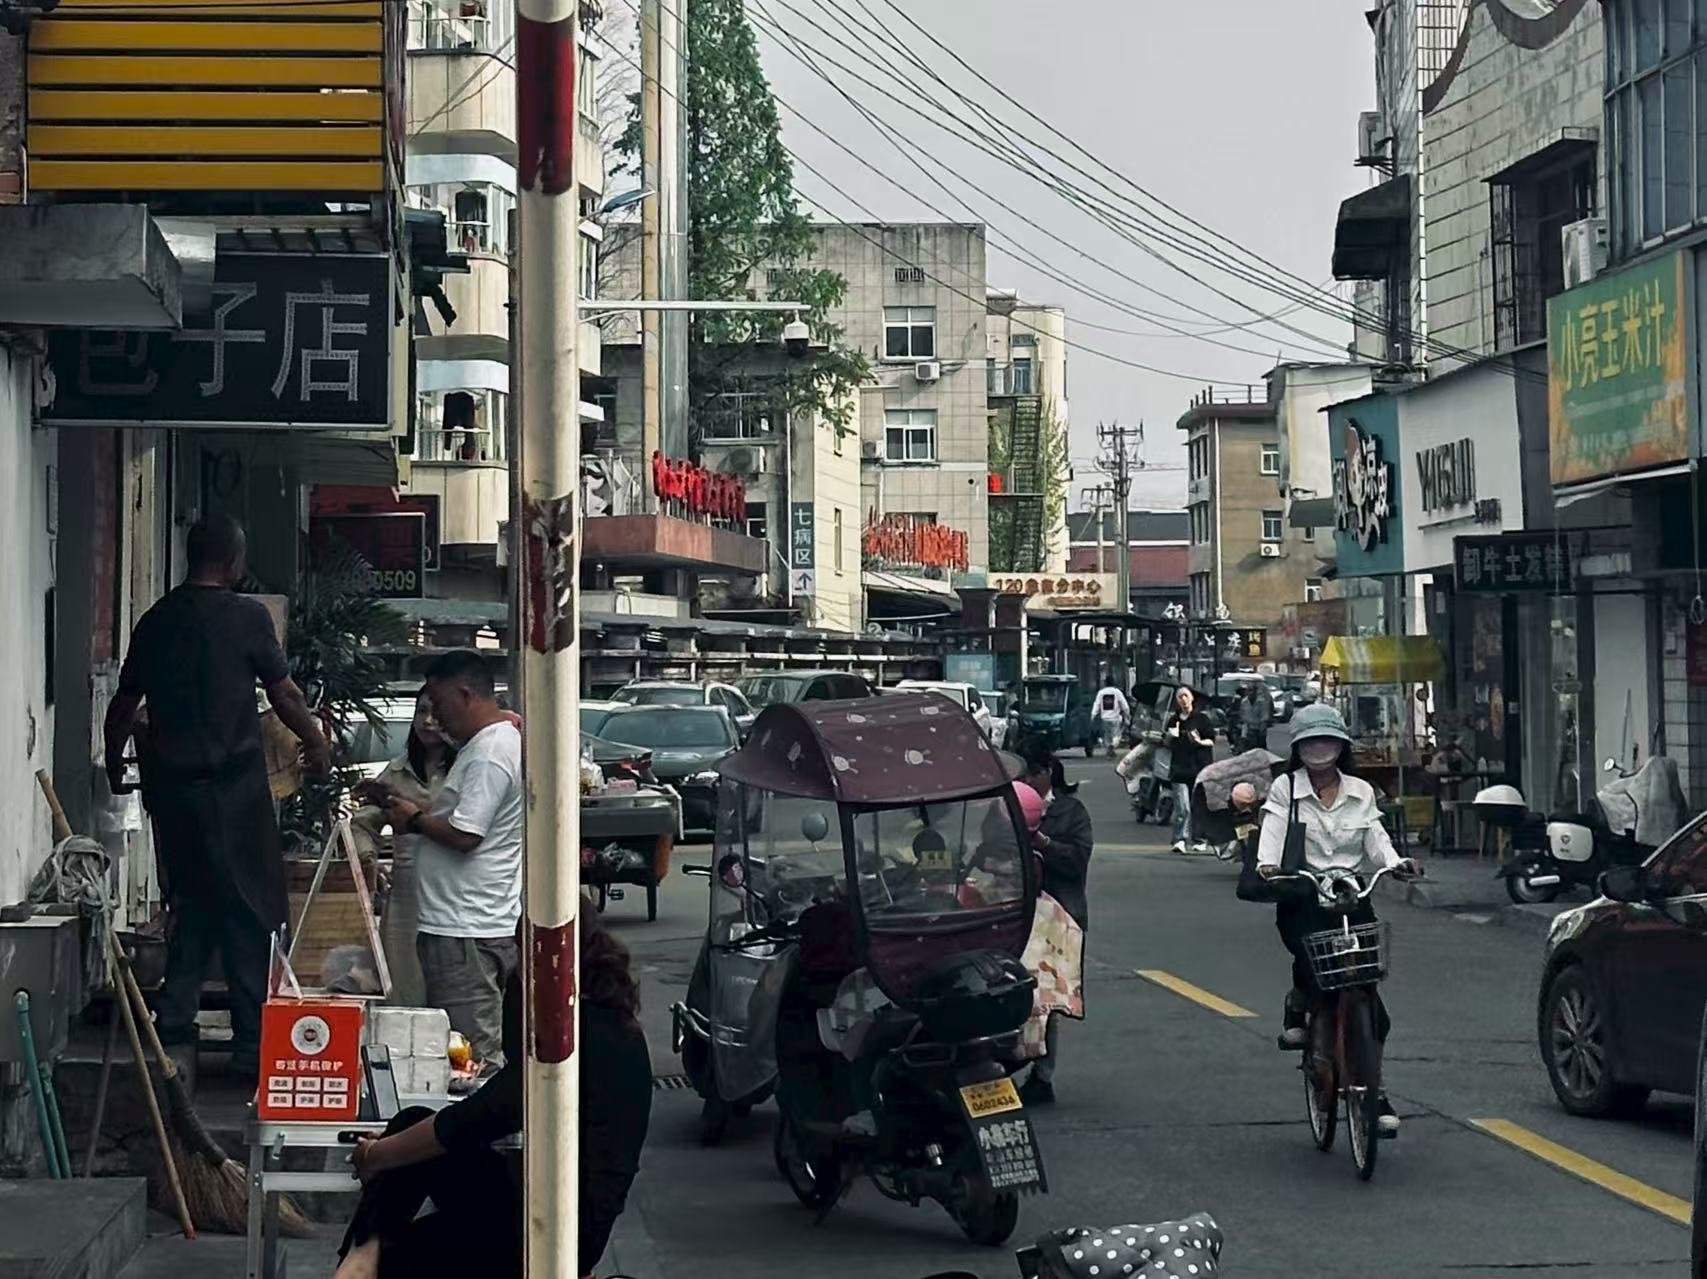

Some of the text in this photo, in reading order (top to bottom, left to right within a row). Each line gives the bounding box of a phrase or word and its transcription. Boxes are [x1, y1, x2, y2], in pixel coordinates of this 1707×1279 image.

[1560, 279, 1665, 391] 小亮玉米汁
[794, 508, 812, 564] 七病区
